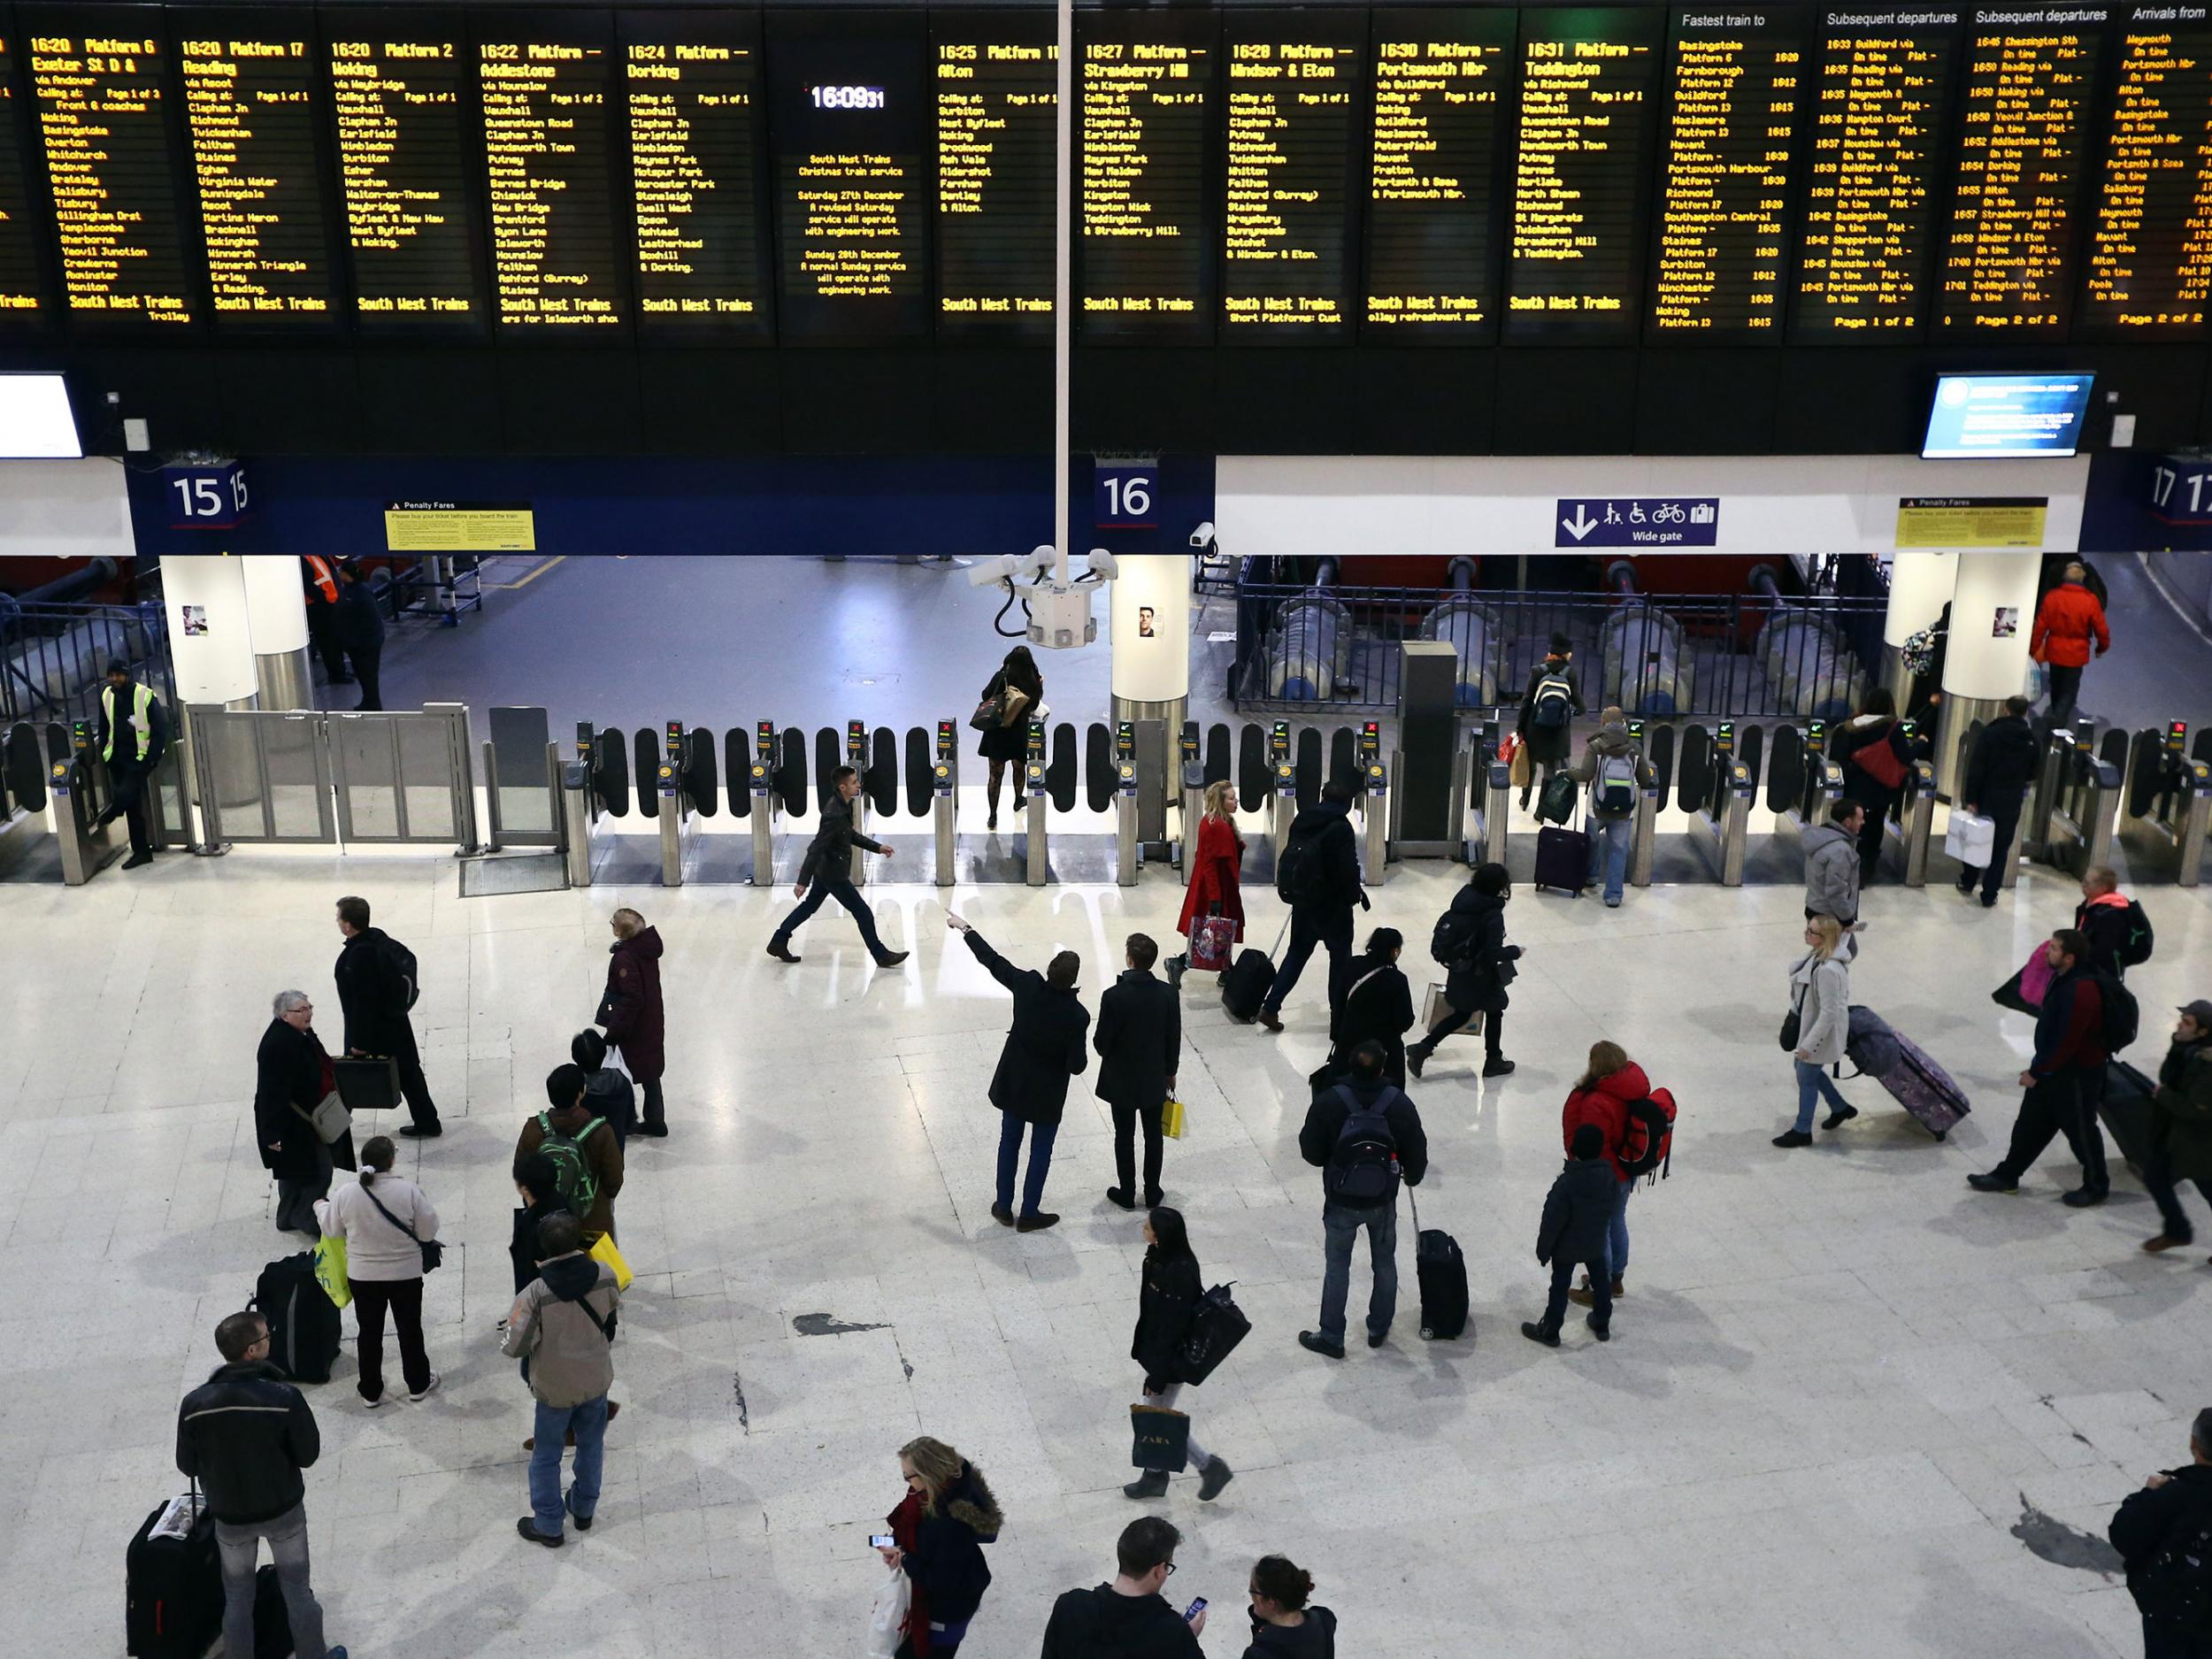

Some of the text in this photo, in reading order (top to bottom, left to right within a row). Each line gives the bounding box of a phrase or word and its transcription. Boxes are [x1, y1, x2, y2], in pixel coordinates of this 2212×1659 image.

[1977, 10, 2107, 24] Subsequent departures
[2132, 7, 2205, 19] Arrivals from
[1683, 14, 1764, 26] Fastest train to
[1828, 12, 1957, 27] Subsequent departures
[85, 39, 142, 54] Platform
[144, 40, 156, 54] 6
[229, 42, 285, 57] Platform
[290, 42, 303, 56] 17
[385, 43, 439, 58] Platform
[443, 43, 453, 58] 2
[528, 44, 582, 59] Platform
[676, 45, 729, 59] Platform
[988, 45, 1041, 59] Platform
[1133, 45, 1187, 59] Platform
[1280, 44, 1333, 58] Platform
[1427, 43, 1481, 58] Platform
[1576, 42, 1629, 57] Platform
[1678, 41, 1743, 52] Basingstoke
[1683, 53, 1732, 63] Platform 6
[32, 57, 136, 73] Exeter St D &
[182, 60, 237, 77] Reading
[332, 62, 378, 78] Woking
[480, 64, 556, 78] Addlestone
[1231, 64, 1334, 77] Windsor & Eton
[1378, 62, 1487, 76] Portsmouth Hbr
[1525, 62, 1601, 78] Teddington
[1677, 65, 1743, 77] Farnborough
[627, 65, 680, 80] Dorking
[938, 65, 972, 78] Alton
[1085, 64, 1164, 79] Strawberry
[1101, 81, 1148, 93] Kingston
[1675, 91, 1726, 100] Guildford
[188, 103, 249, 114] Clapham Jn
[939, 106, 985, 116] Surbiton
[190, 116, 239, 126] Richmond
[1376, 117, 1427, 127] Guildford
[43, 125, 109, 137] Basingstoke
[632, 131, 688, 141] Earlsfield
[1229, 130, 1264, 142] Putney
[194, 140, 235, 150] Feltham
[488, 142, 575, 152] Wandsworth Town
[1229, 142, 1276, 151] Richmond
[1671, 140, 1705, 150] Havant
[47, 150, 107, 160] Whitchurch
[488, 155, 524, 165] Putney
[810, 155, 891, 164] South West Trains
[799, 167, 902, 176] Christmas train service
[940, 167, 992, 176] Aldershot
[1373, 165, 1414, 174] Fratton
[1668, 164, 1772, 173] Portsmouth Harbour
[198, 177, 278, 188] Virginia Water
[636, 191, 692, 203] Stoneleigh
[798, 191, 838, 202] Saturday
[864, 191, 904, 200] December
[1517, 189, 1580, 198] North Sheen
[1228, 203, 1267, 211] Staines
[637, 215, 667, 226] Epsom
[1085, 214, 1141, 226] Teddington
[639, 239, 703, 248] Leatherhead
[62, 247, 148, 257] Yeovil Junction
[805, 250, 901, 261] Sunday 28th December
[67, 282, 109, 291] Honiton
[818, 286, 866, 296] engineering
[70, 296, 183, 308] South West Trains
[149, 311, 189, 322] Trolley
[1230, 313, 1258, 322] Short
[1262, 313, 1315, 322] Platforms:
[230, 469, 248, 511] 15
[2154, 466, 2176, 507] 17
[173, 478, 222, 516] 15
[1103, 477, 1150, 515] 16
[1632, 532, 1682, 542] Wide gate
[1141, 1435, 1170, 1445] ZARA
